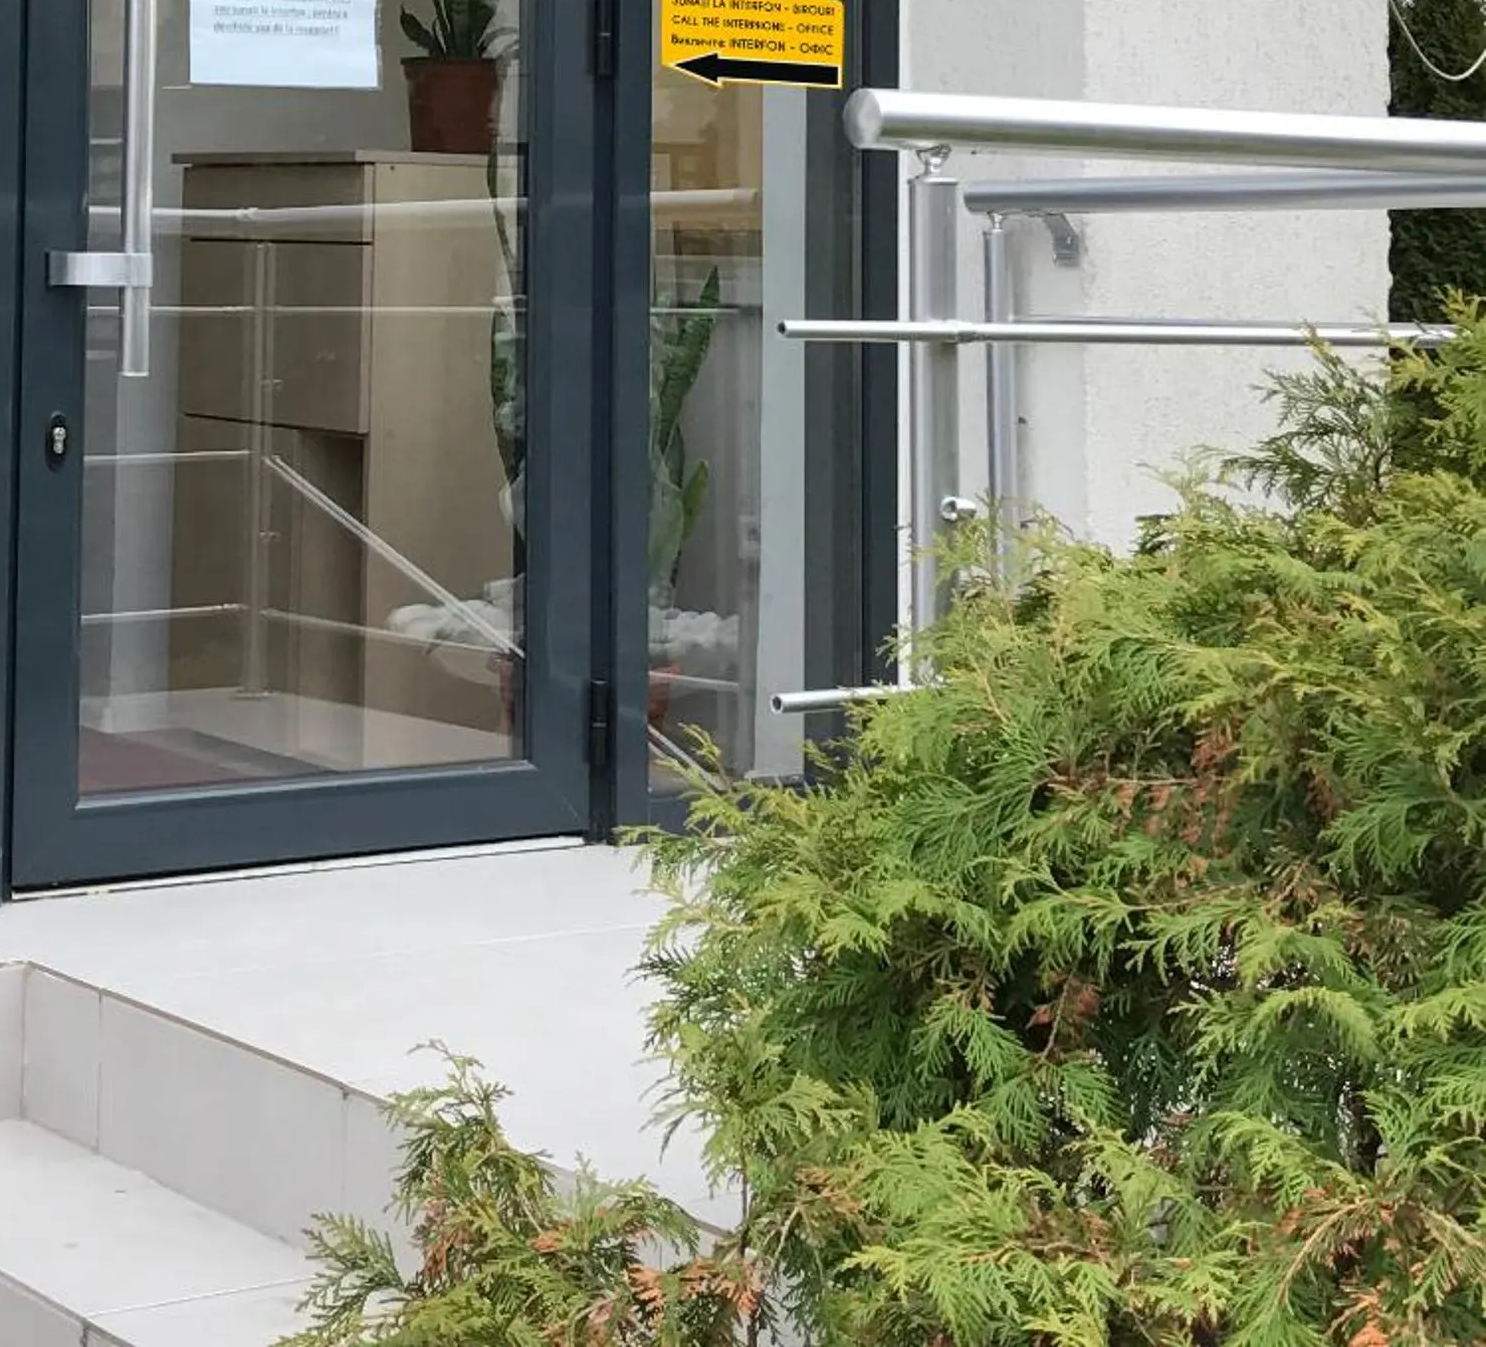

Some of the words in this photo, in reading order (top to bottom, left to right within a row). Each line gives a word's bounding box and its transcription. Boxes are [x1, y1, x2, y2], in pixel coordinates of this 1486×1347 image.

[672, 14, 698, 26] CALL
[702, 17, 720, 27] THE
[797, 22, 835, 35] OFFICE
